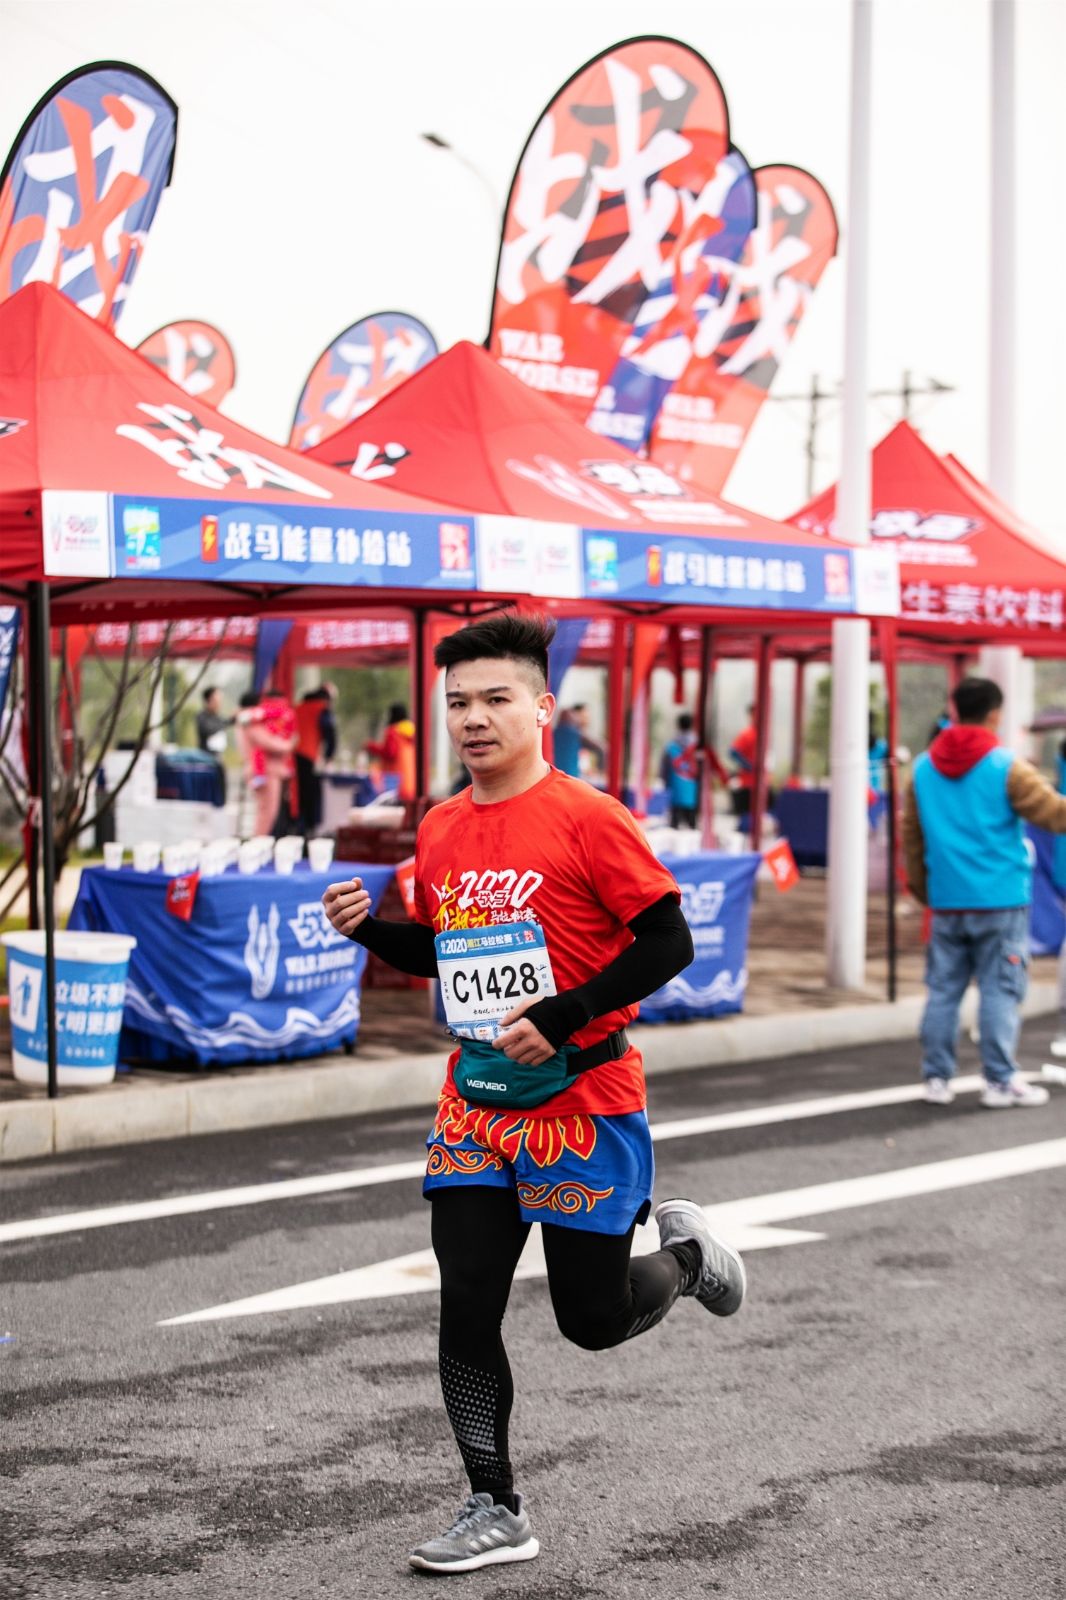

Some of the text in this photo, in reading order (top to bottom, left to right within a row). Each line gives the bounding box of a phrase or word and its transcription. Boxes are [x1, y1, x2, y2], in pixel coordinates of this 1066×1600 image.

[224, 521, 412, 568] 战马能量补给站
[453, 963, 539, 1004] C1428
